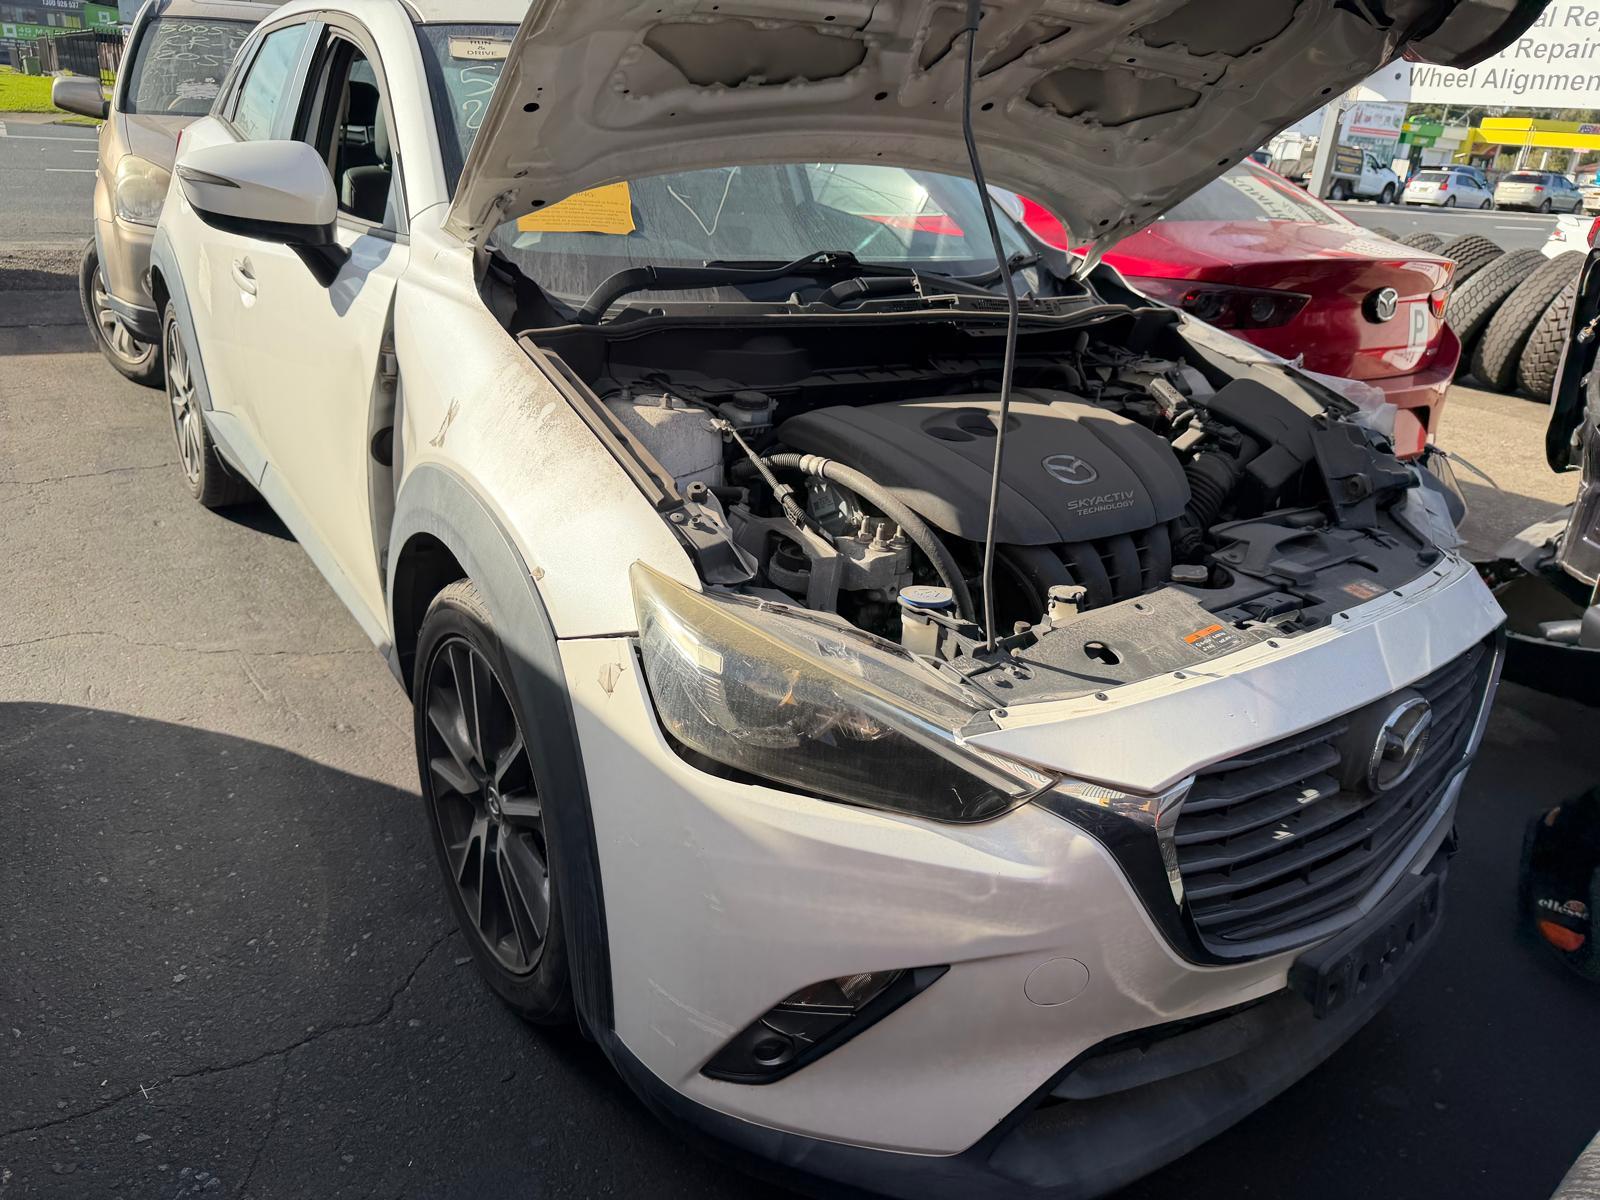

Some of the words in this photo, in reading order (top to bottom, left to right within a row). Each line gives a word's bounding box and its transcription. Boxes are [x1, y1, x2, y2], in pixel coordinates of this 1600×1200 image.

[1563, 6, 1600, 32] Re
[1409, 66, 1477, 88] Wheel
[1480, 68, 1600, 95] Alignmen
[1067, 490, 1134, 510] SKYACTIV
[1077, 500, 1135, 516] TECHNOLOGY
